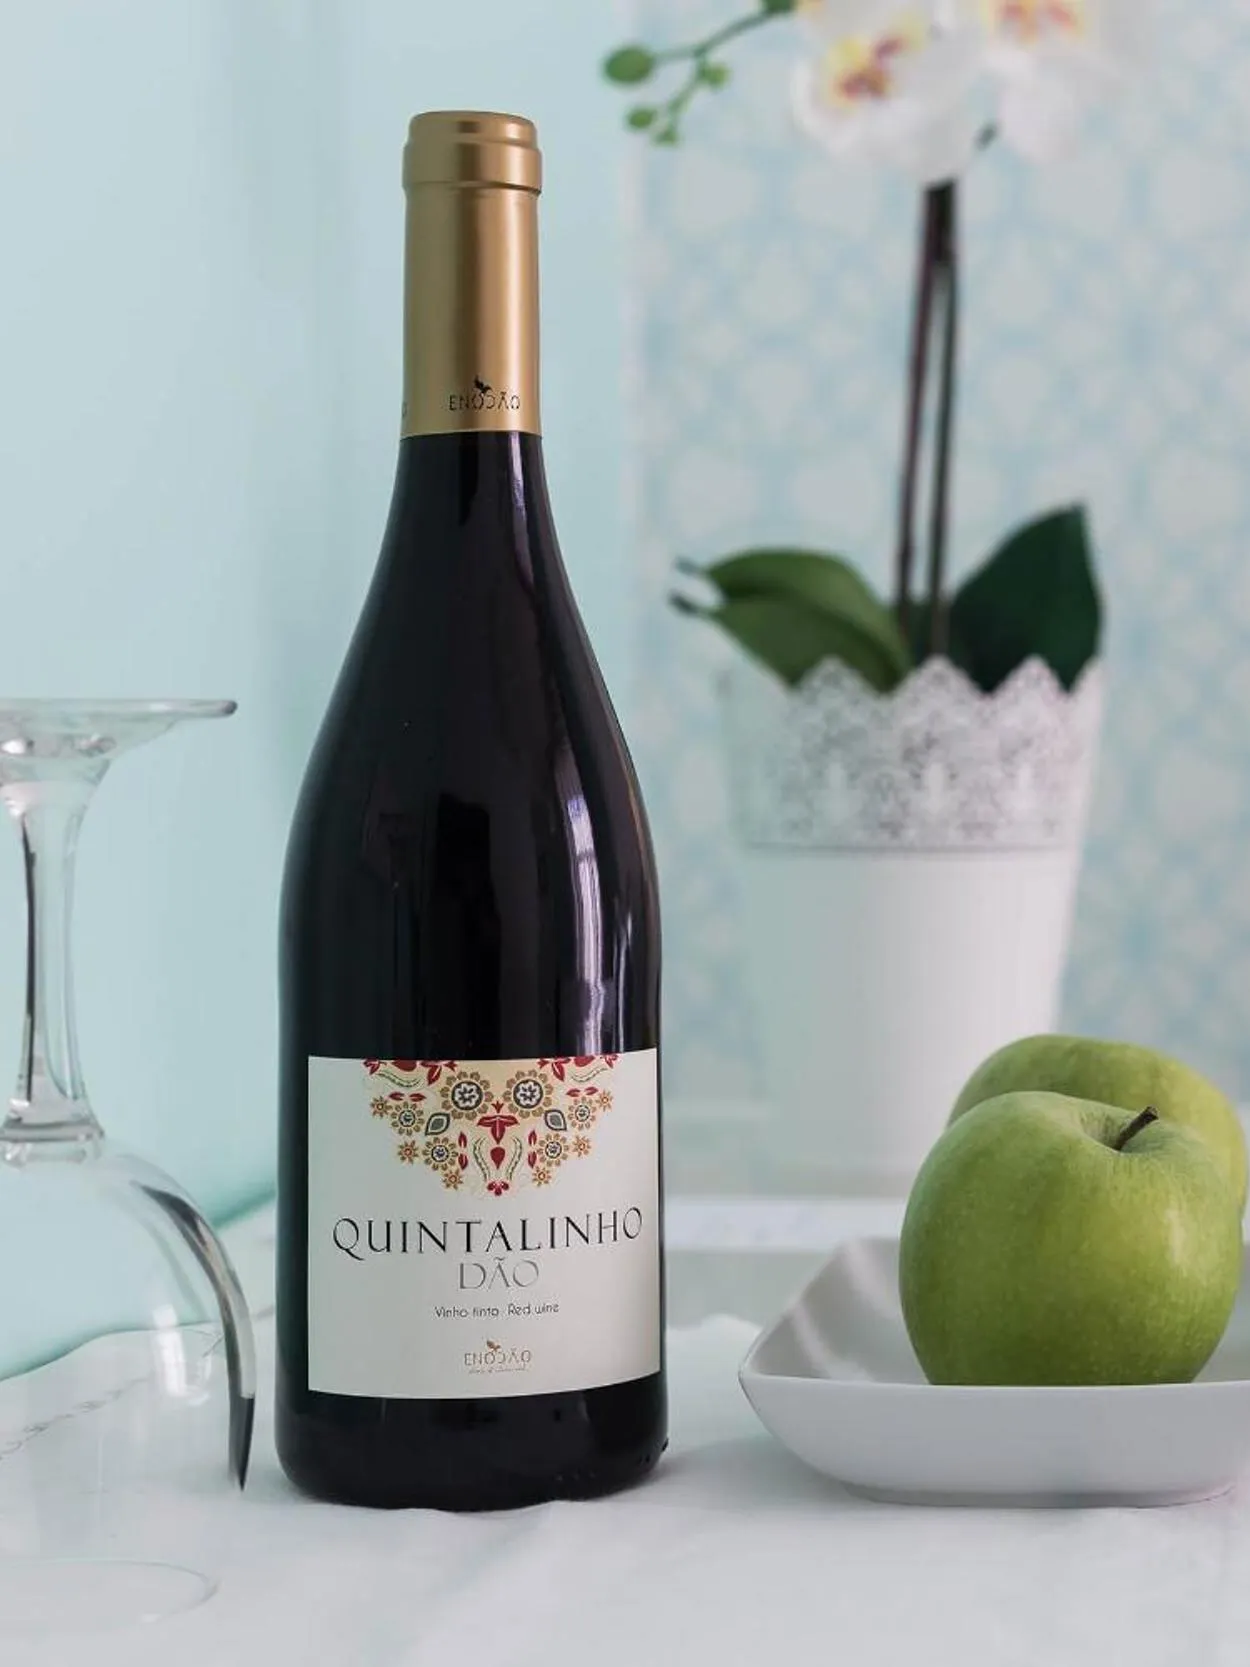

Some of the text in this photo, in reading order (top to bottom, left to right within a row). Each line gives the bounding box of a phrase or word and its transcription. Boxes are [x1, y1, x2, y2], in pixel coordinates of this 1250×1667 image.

[332, 1206, 644, 1261] QUINTALINHO
[459, 1257, 540, 1290] DÃO
[507, 1303, 531, 1316] Red
[534, 1303, 559, 1315] wine
